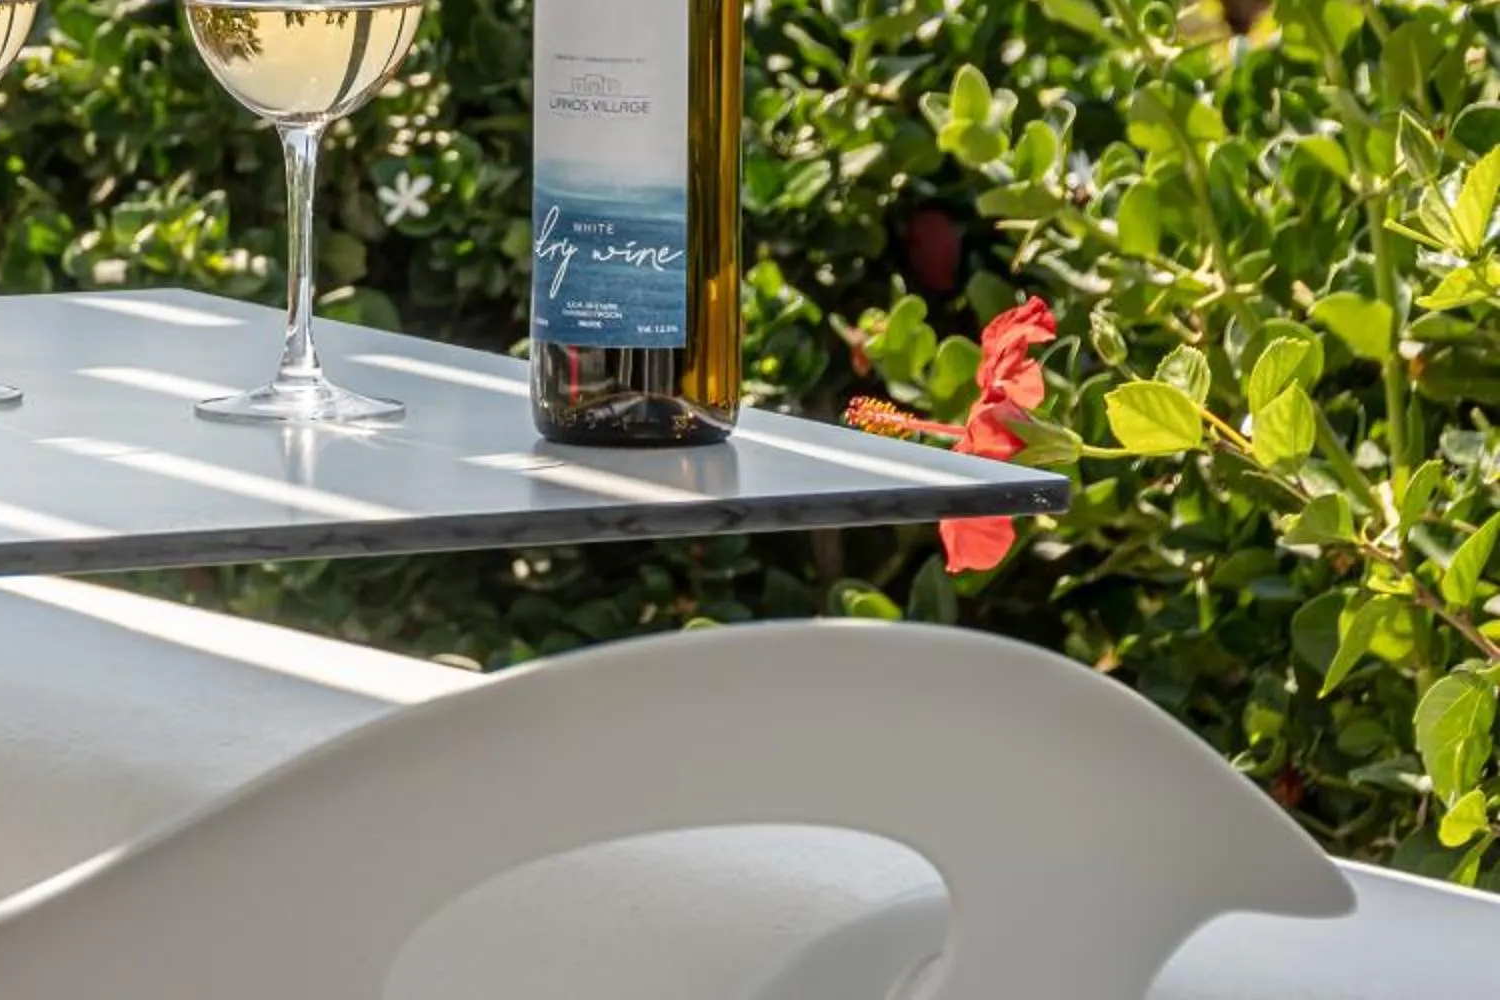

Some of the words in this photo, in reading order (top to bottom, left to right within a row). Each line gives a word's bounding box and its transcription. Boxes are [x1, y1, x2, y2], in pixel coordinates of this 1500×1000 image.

[590, 99, 652, 114] VILLAGE
[572, 222, 615, 235] WHITE
[592, 240, 684, 272] wine
